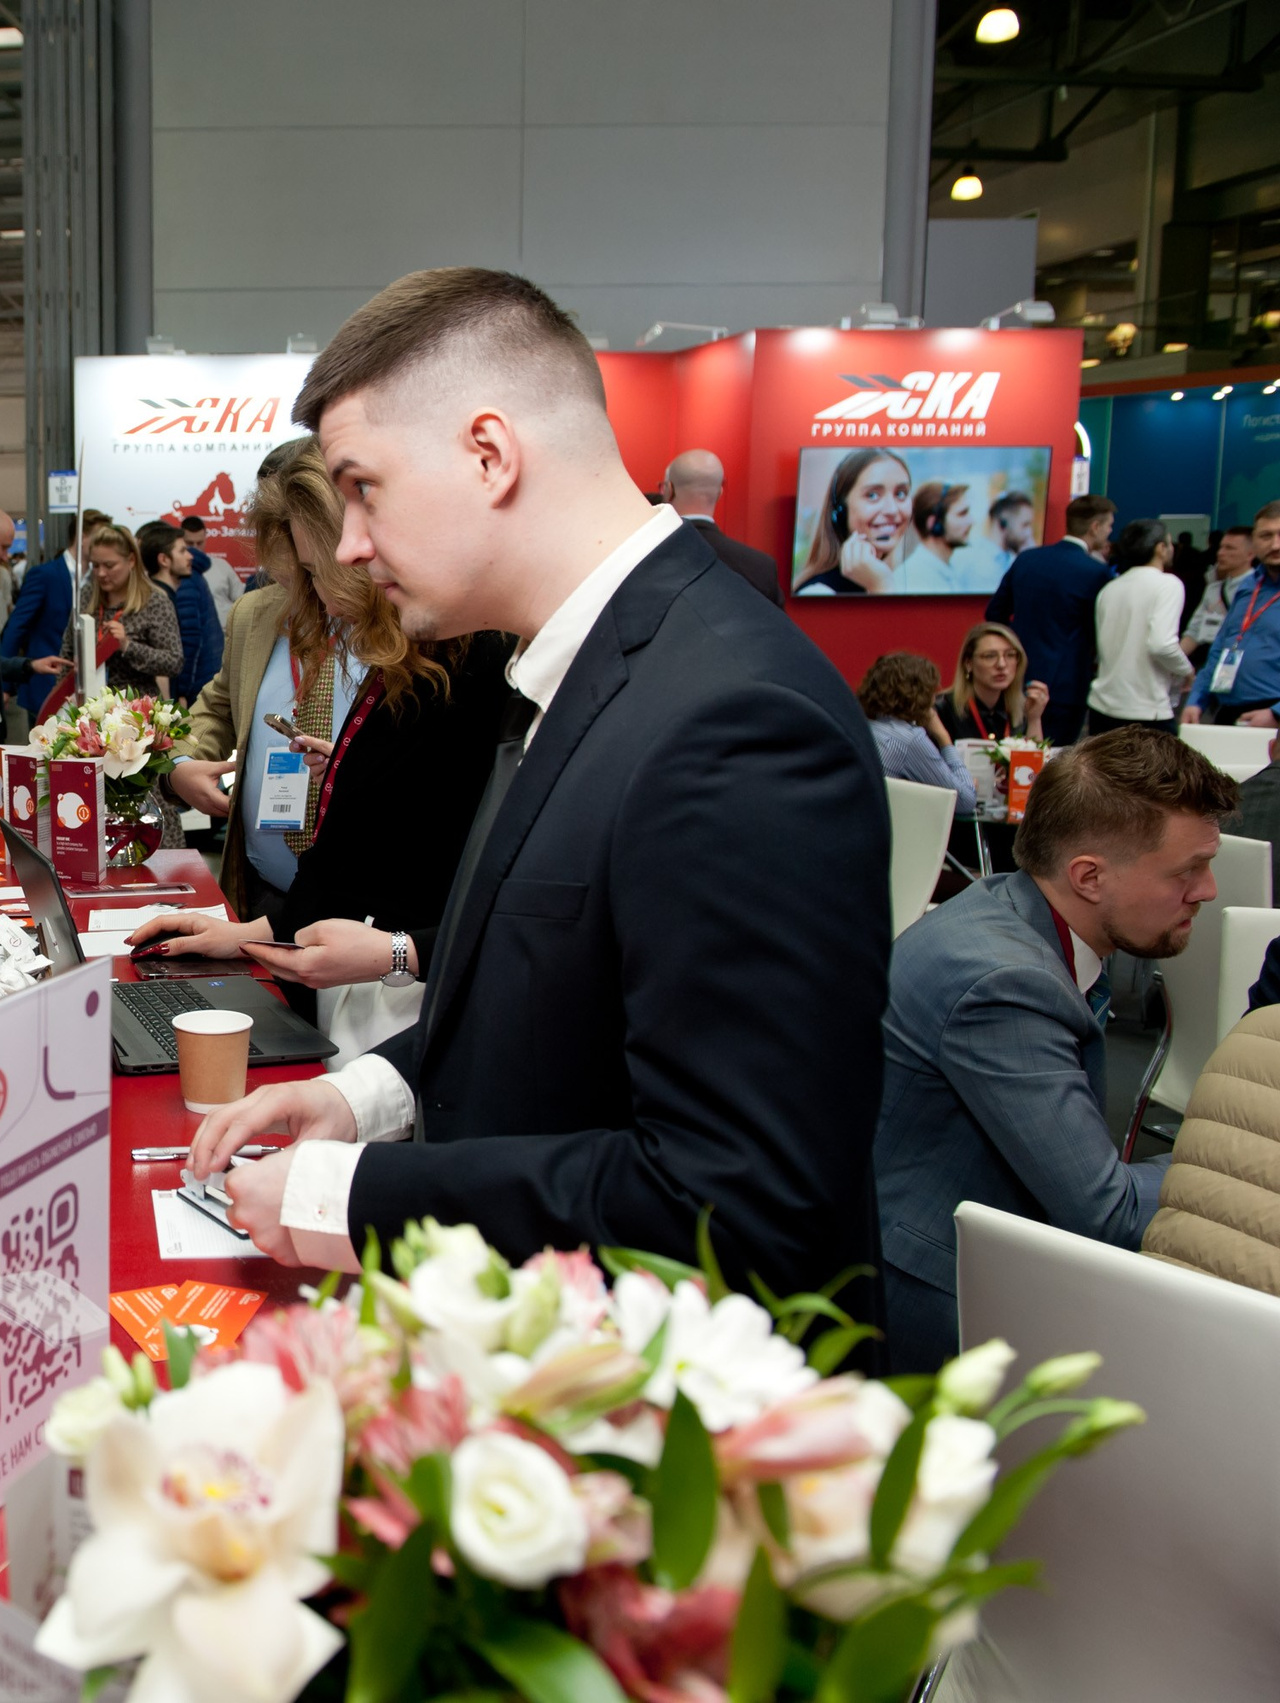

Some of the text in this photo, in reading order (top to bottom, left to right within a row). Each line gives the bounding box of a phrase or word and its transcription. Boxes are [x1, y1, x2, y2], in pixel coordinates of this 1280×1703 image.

[811, 421, 987, 437] ГРУППА КОМПАНИЙ
[113, 441, 274, 454] ГРУППА КОМПАНИЙ
[9, 1431, 32, 1469] НАМ
